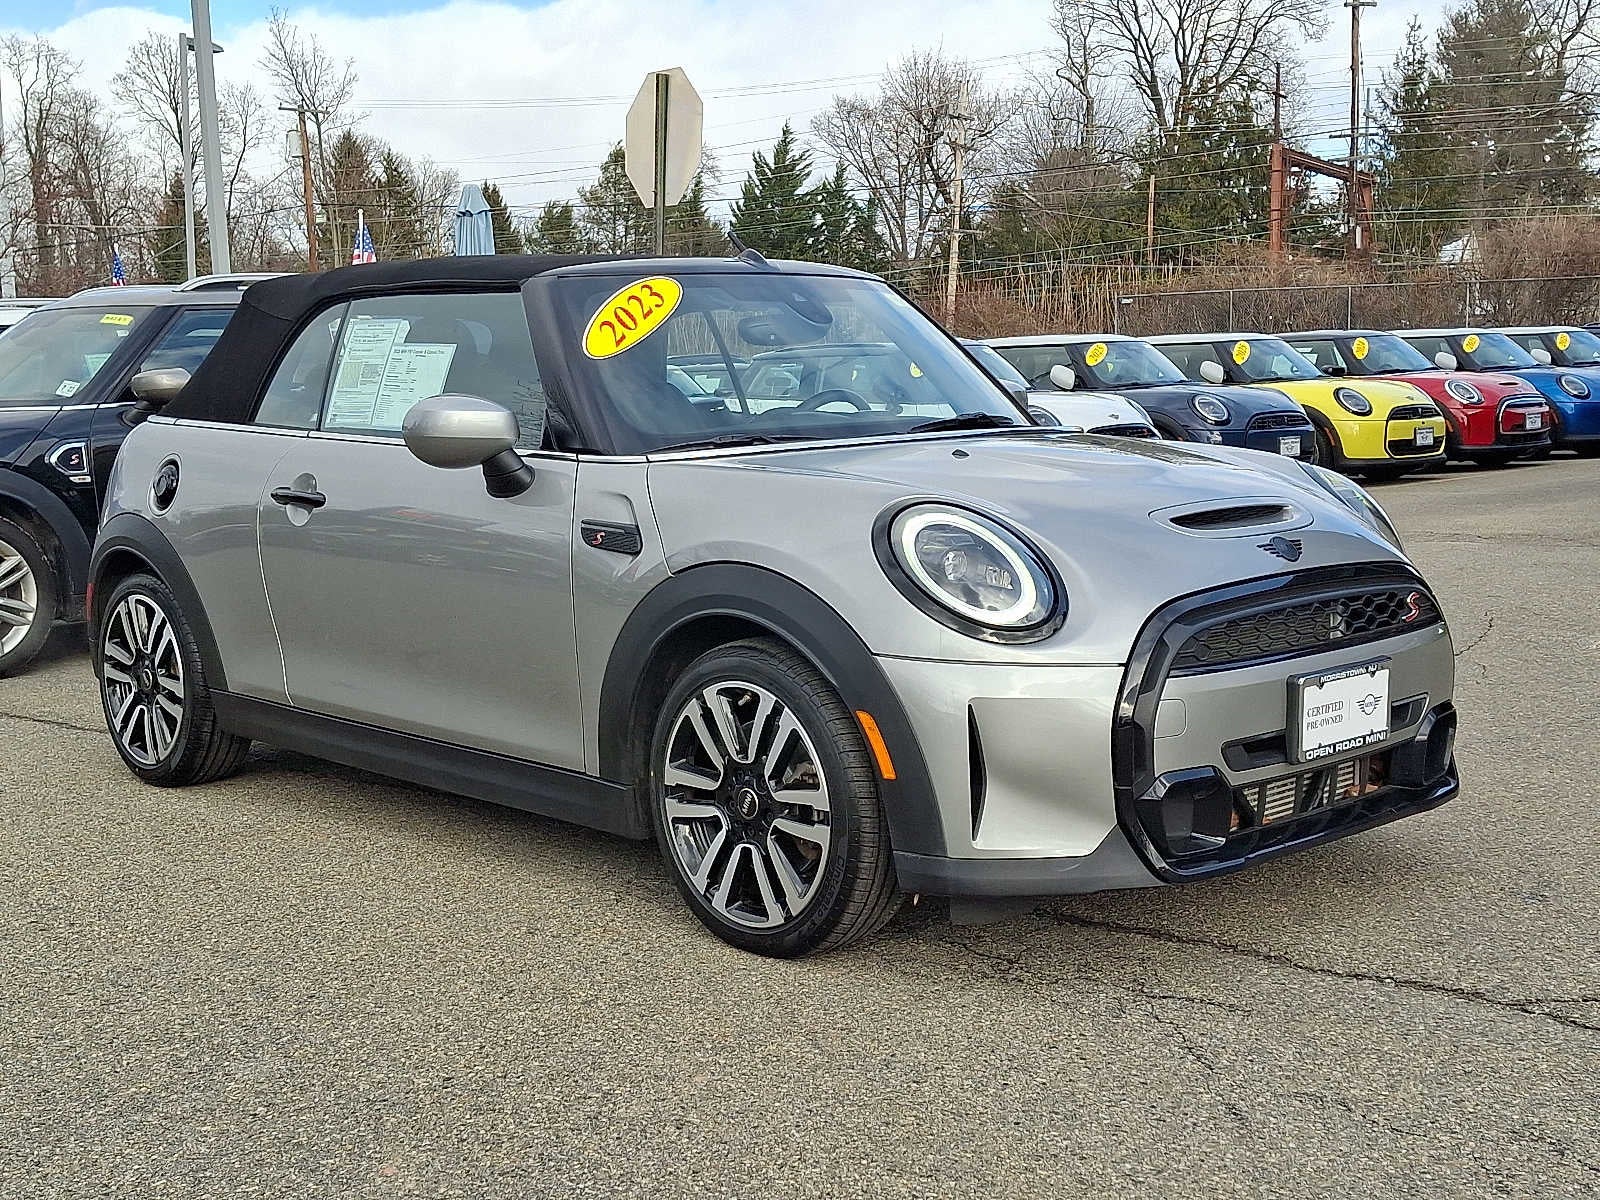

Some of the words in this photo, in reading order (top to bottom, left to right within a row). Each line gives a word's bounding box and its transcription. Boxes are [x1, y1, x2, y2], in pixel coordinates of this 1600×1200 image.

[599, 284, 665, 348] 2023
[591, 531, 606, 546] S
[1401, 591, 1420, 623] S
[1307, 700, 1344, 718] CERTIFIED
[1306, 713, 1344, 731] PRE-OWNED
[1305, 745, 1334, 760] OPEN
[1335, 737, 1364, 752] ROAD
[1365, 731, 1387, 745] MINI
